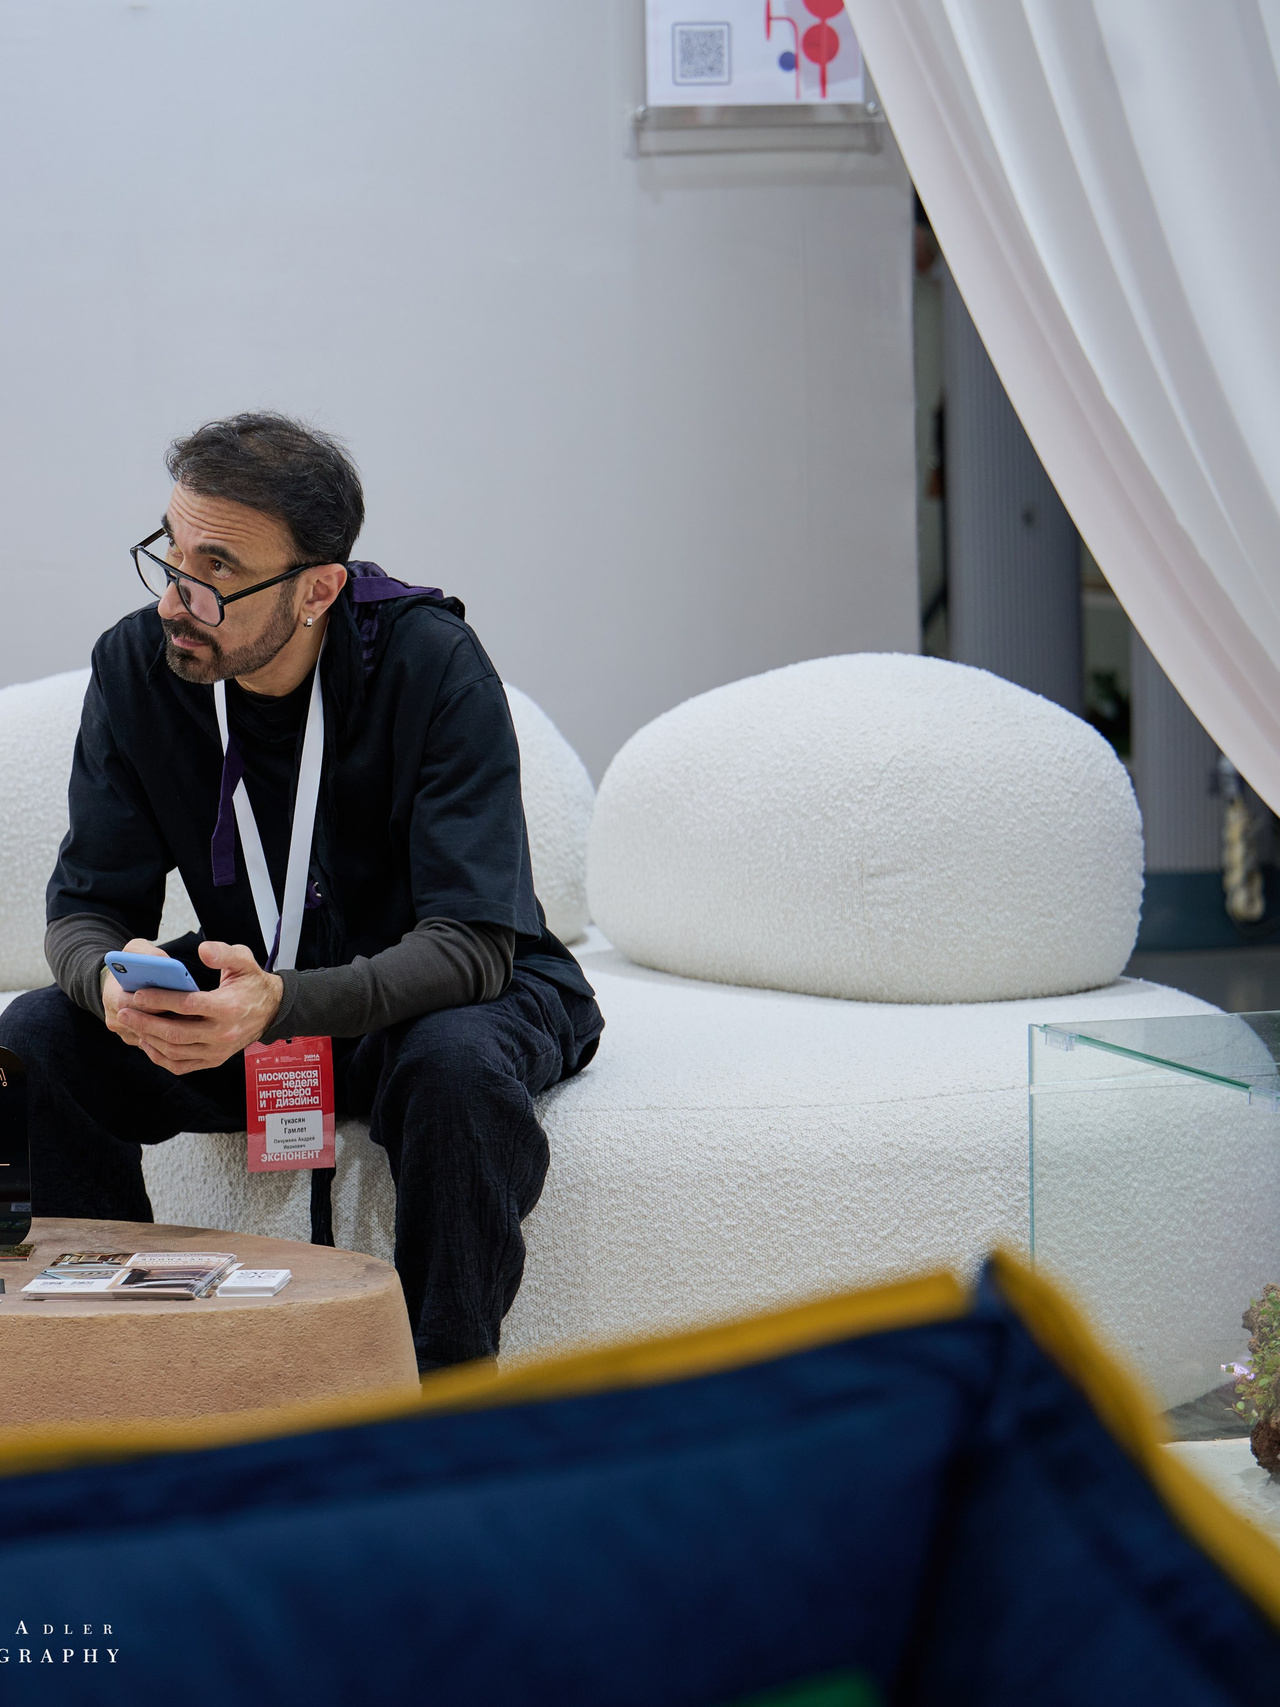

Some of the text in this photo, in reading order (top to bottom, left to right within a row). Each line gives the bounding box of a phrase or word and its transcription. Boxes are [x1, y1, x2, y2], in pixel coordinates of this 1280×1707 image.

[282, 1078, 319, 1089] неделя
[259, 1087, 311, 1100] интерьера
[275, 1095, 320, 1108] дизайна
[280, 1117, 306, 1126] Гукасян
[261, 1150, 321, 1162] ЭКСПОНЕНТ
